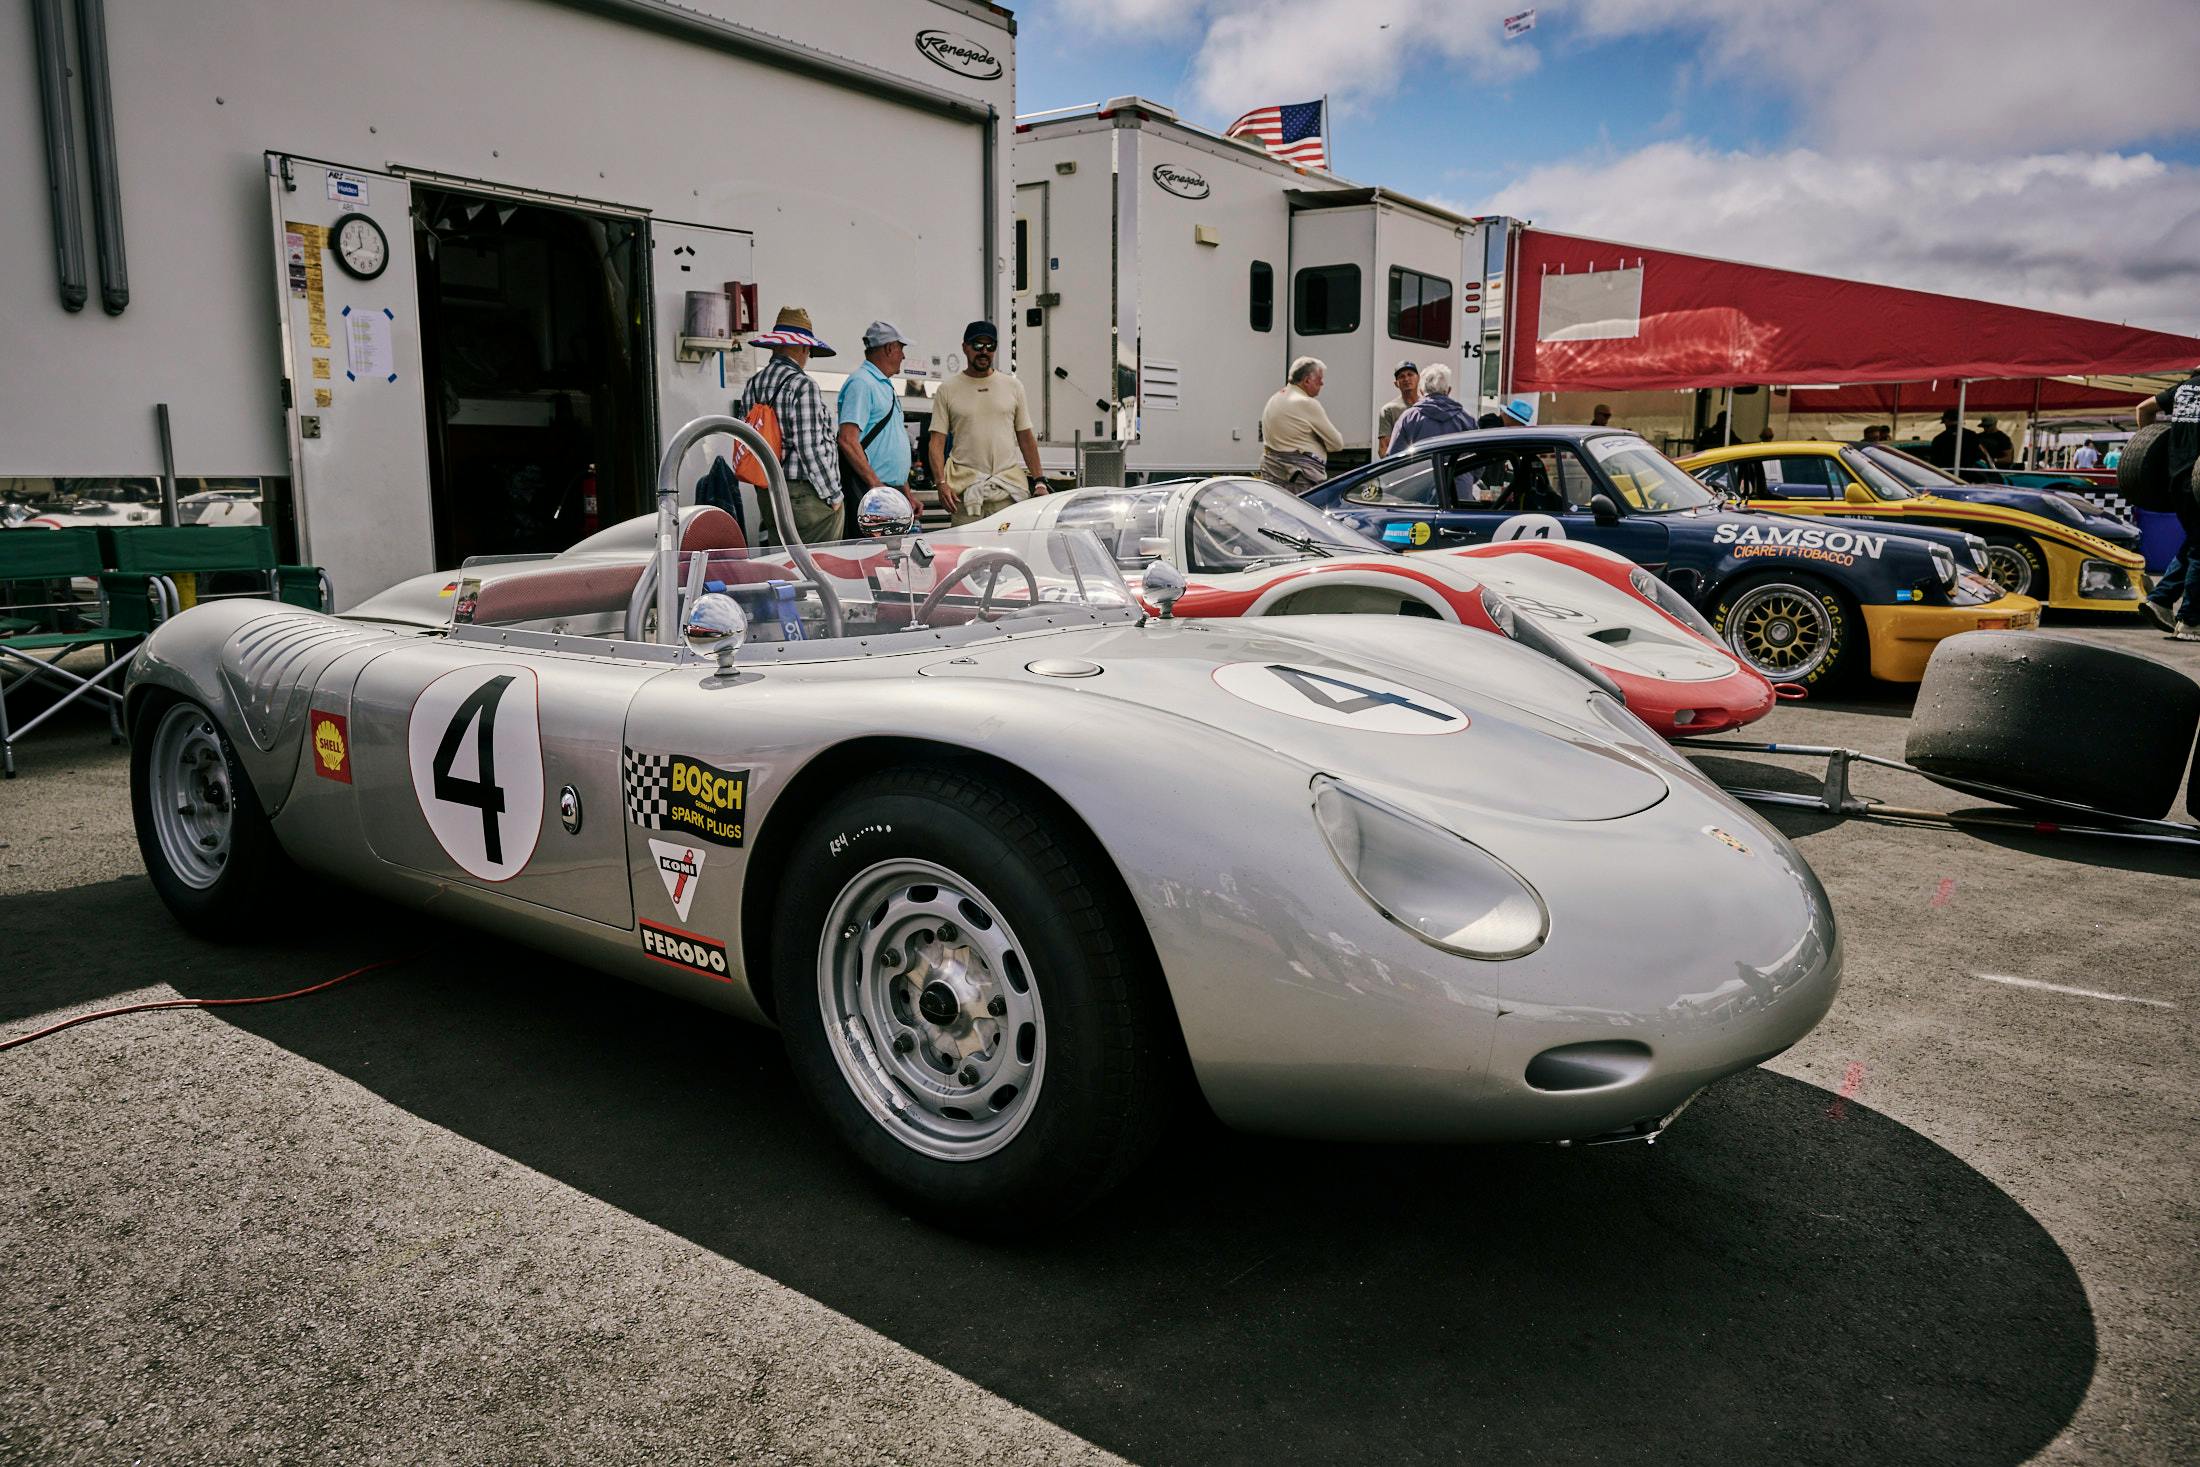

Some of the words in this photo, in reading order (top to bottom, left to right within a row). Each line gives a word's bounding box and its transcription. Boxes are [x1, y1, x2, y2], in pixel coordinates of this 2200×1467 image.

[921, 37, 995, 65] Renegade
[1157, 170, 1205, 190] Renegade
[1464, 341, 1482, 358] ts
[1713, 523, 1887, 559] SAMSON
[1734, 545, 1853, 567] CIGARETT-TOBACCO
[2015, 542, 2040, 570] EAGLE
[1713, 603, 1728, 633] GLE
[1264, 664, 1457, 721] 4
[319, 738, 341, 753] SHELL
[433, 675, 517, 865] 4
[672, 762, 743, 809] BOSCH
[671, 806, 705, 829] SPARK
[706, 817, 742, 839] PLUGS
[662, 858, 695, 874] KONI
[642, 928, 726, 972] FERODO
